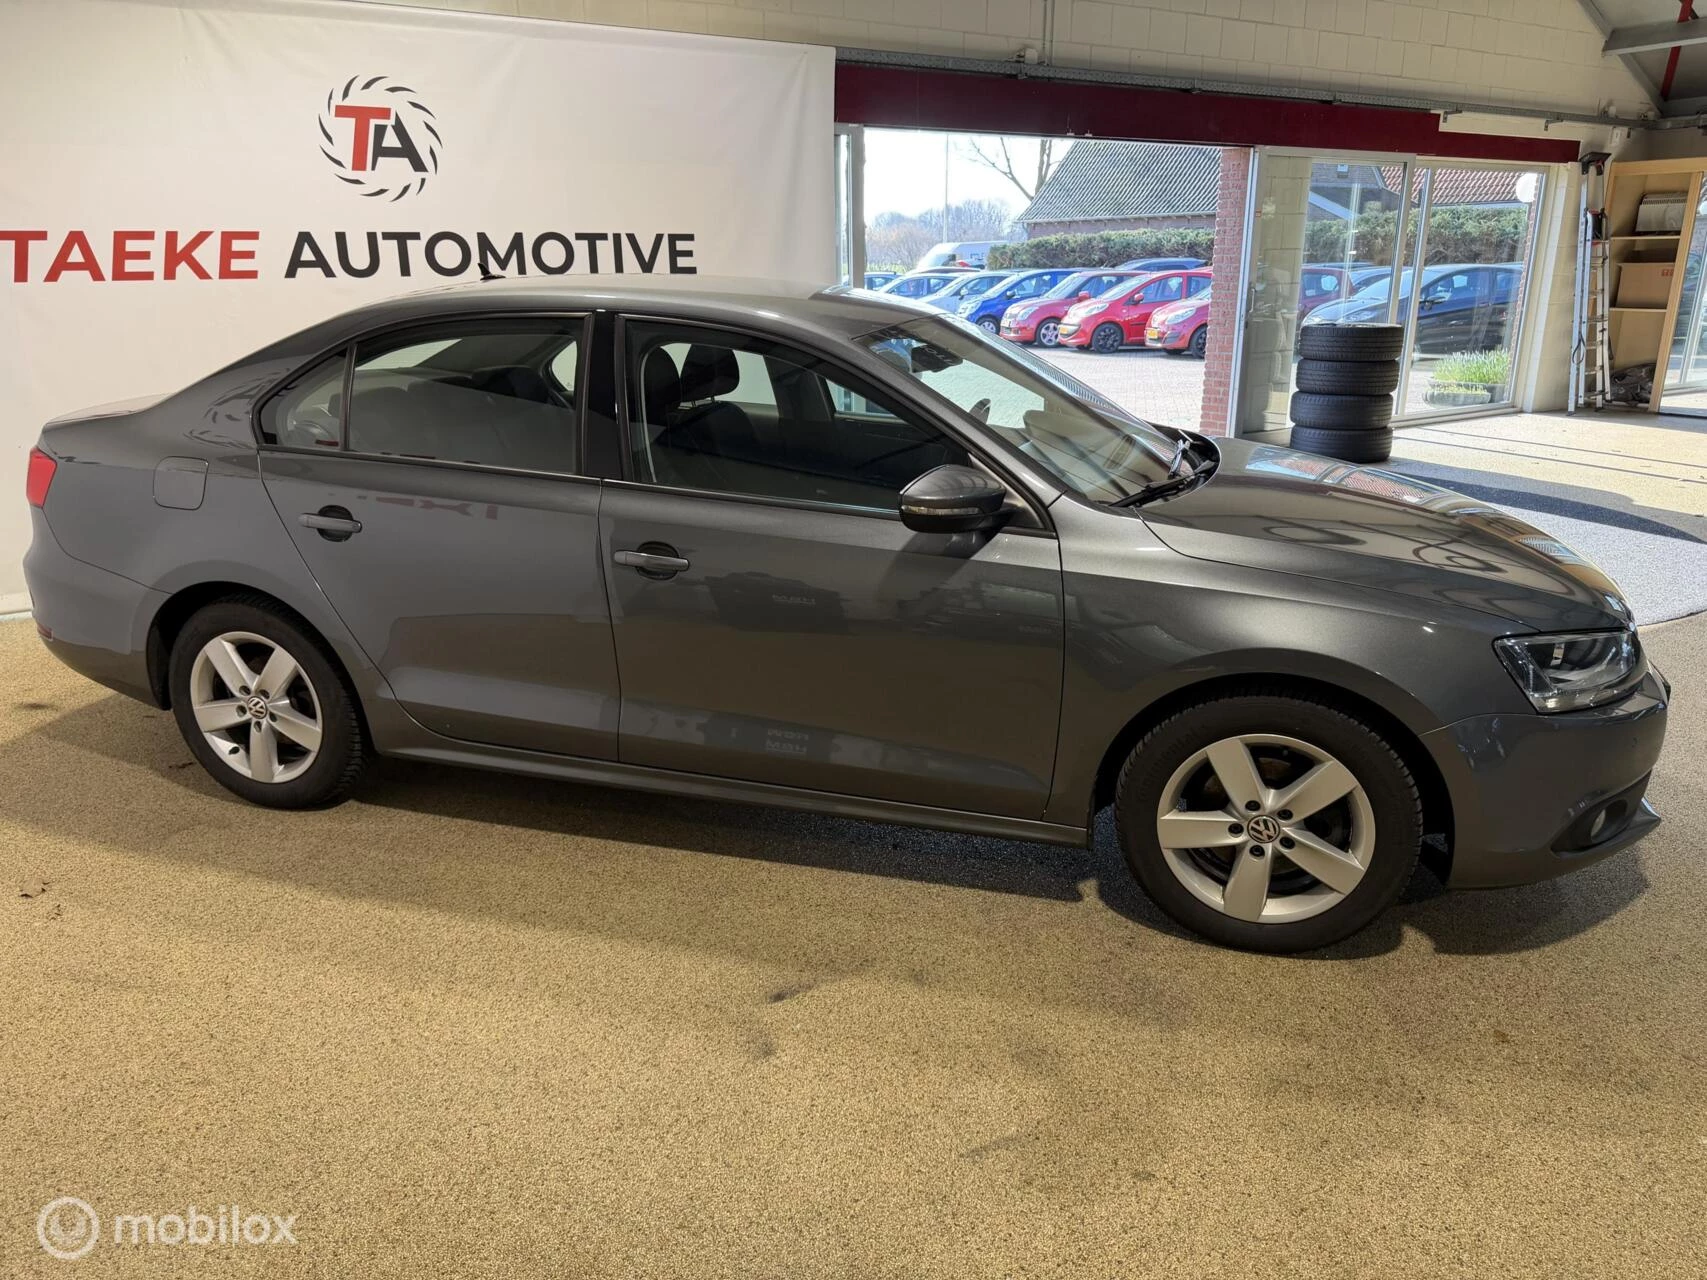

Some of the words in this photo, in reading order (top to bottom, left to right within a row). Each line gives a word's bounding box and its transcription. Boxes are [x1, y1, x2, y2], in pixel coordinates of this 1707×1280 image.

[334, 104, 429, 173] TA
[0, 230, 260, 283] TAEKE
[284, 231, 697, 278] AUTOMOTIVE
